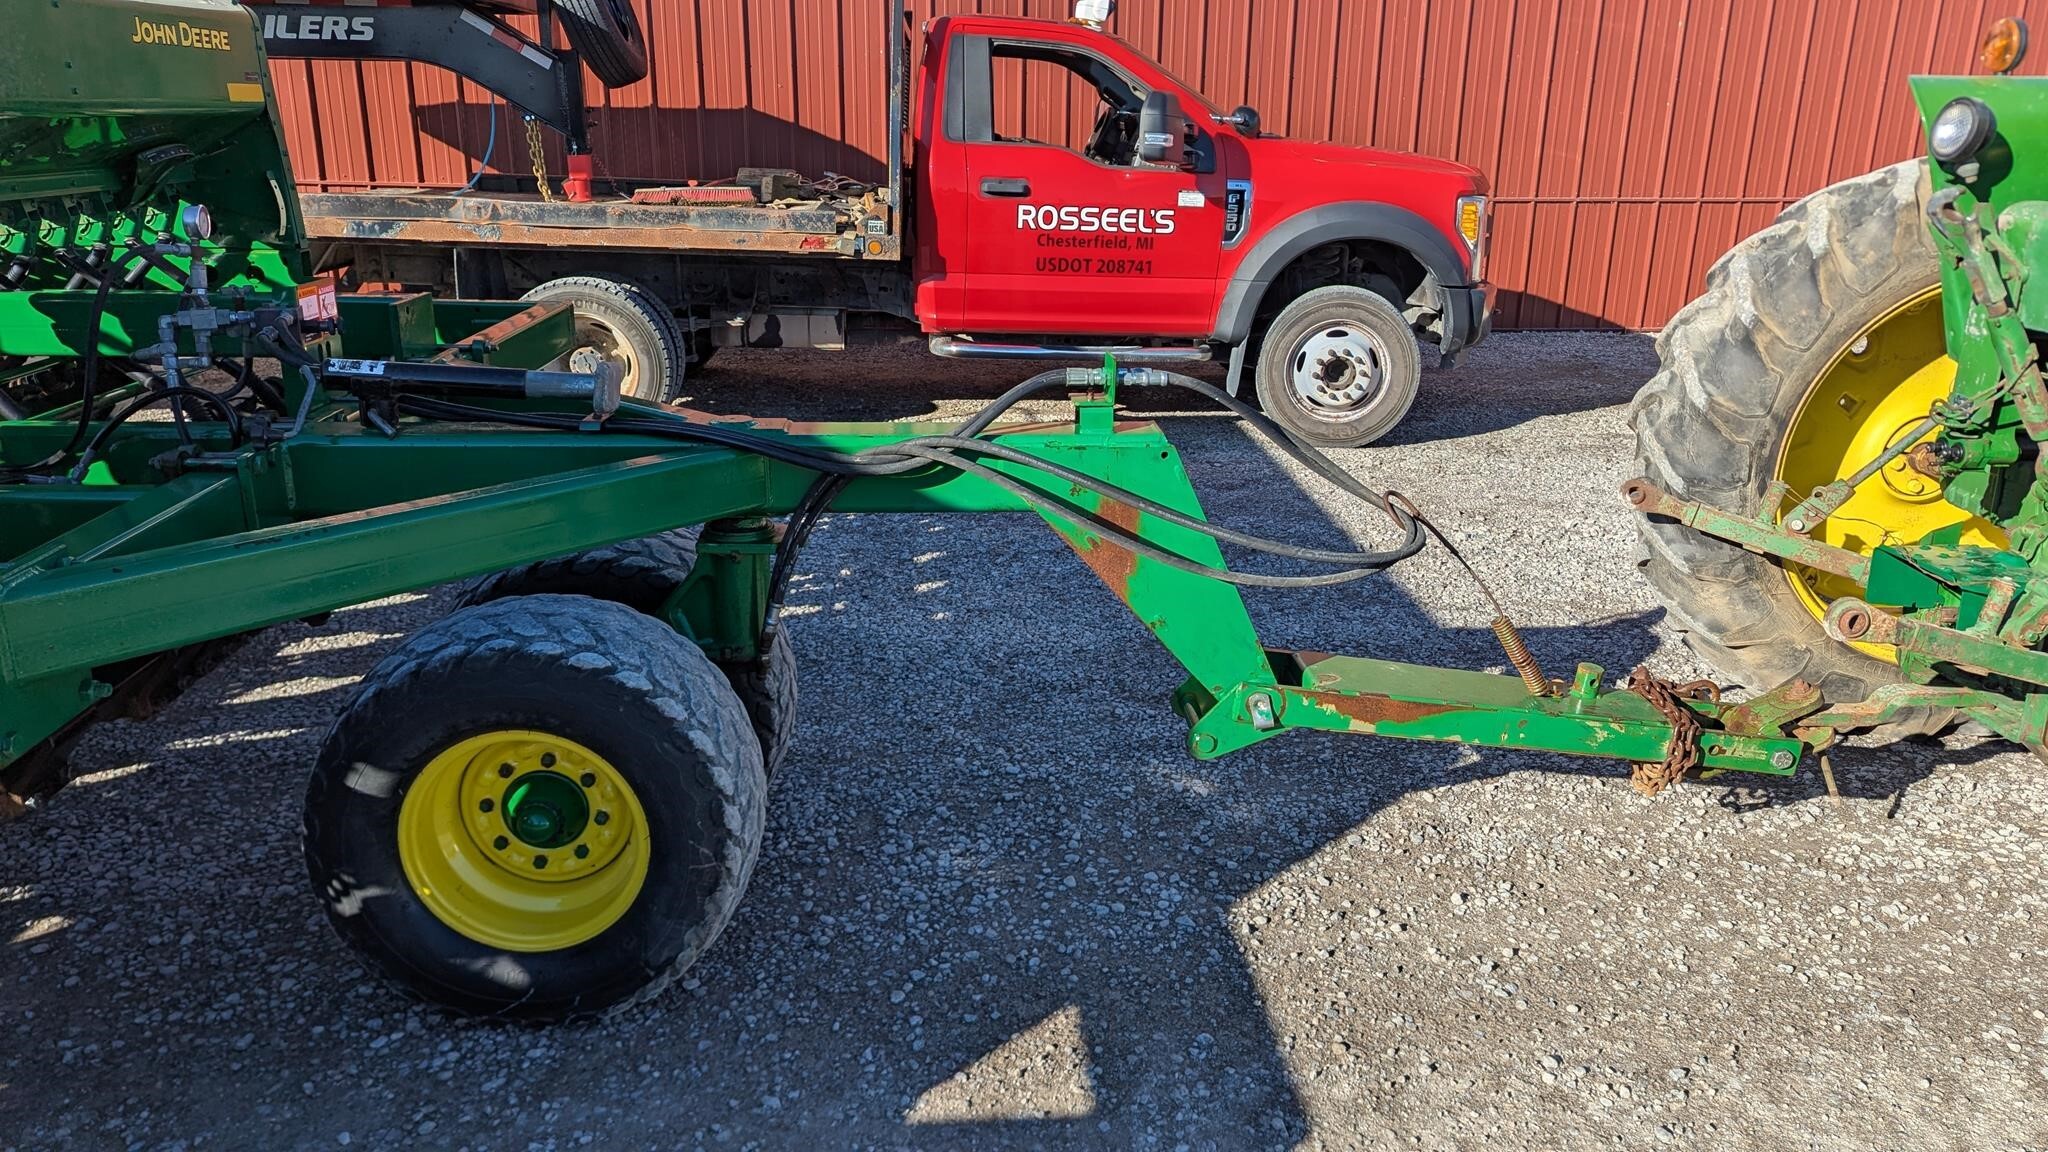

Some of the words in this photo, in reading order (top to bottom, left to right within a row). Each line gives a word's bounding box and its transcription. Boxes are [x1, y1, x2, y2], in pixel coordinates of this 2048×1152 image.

[132, 16, 178, 45] JOHN
[178, 21, 231, 51] DEERE
[1016, 204, 1175, 235] ROSSEEL'S
[869, 225, 884, 233] USA
[1036, 233, 1132, 251] Chesterfield,
[1135, 236, 1154, 250] MI
[1036, 257, 1093, 273] USDOT
[1096, 259, 1153, 275] 208741
